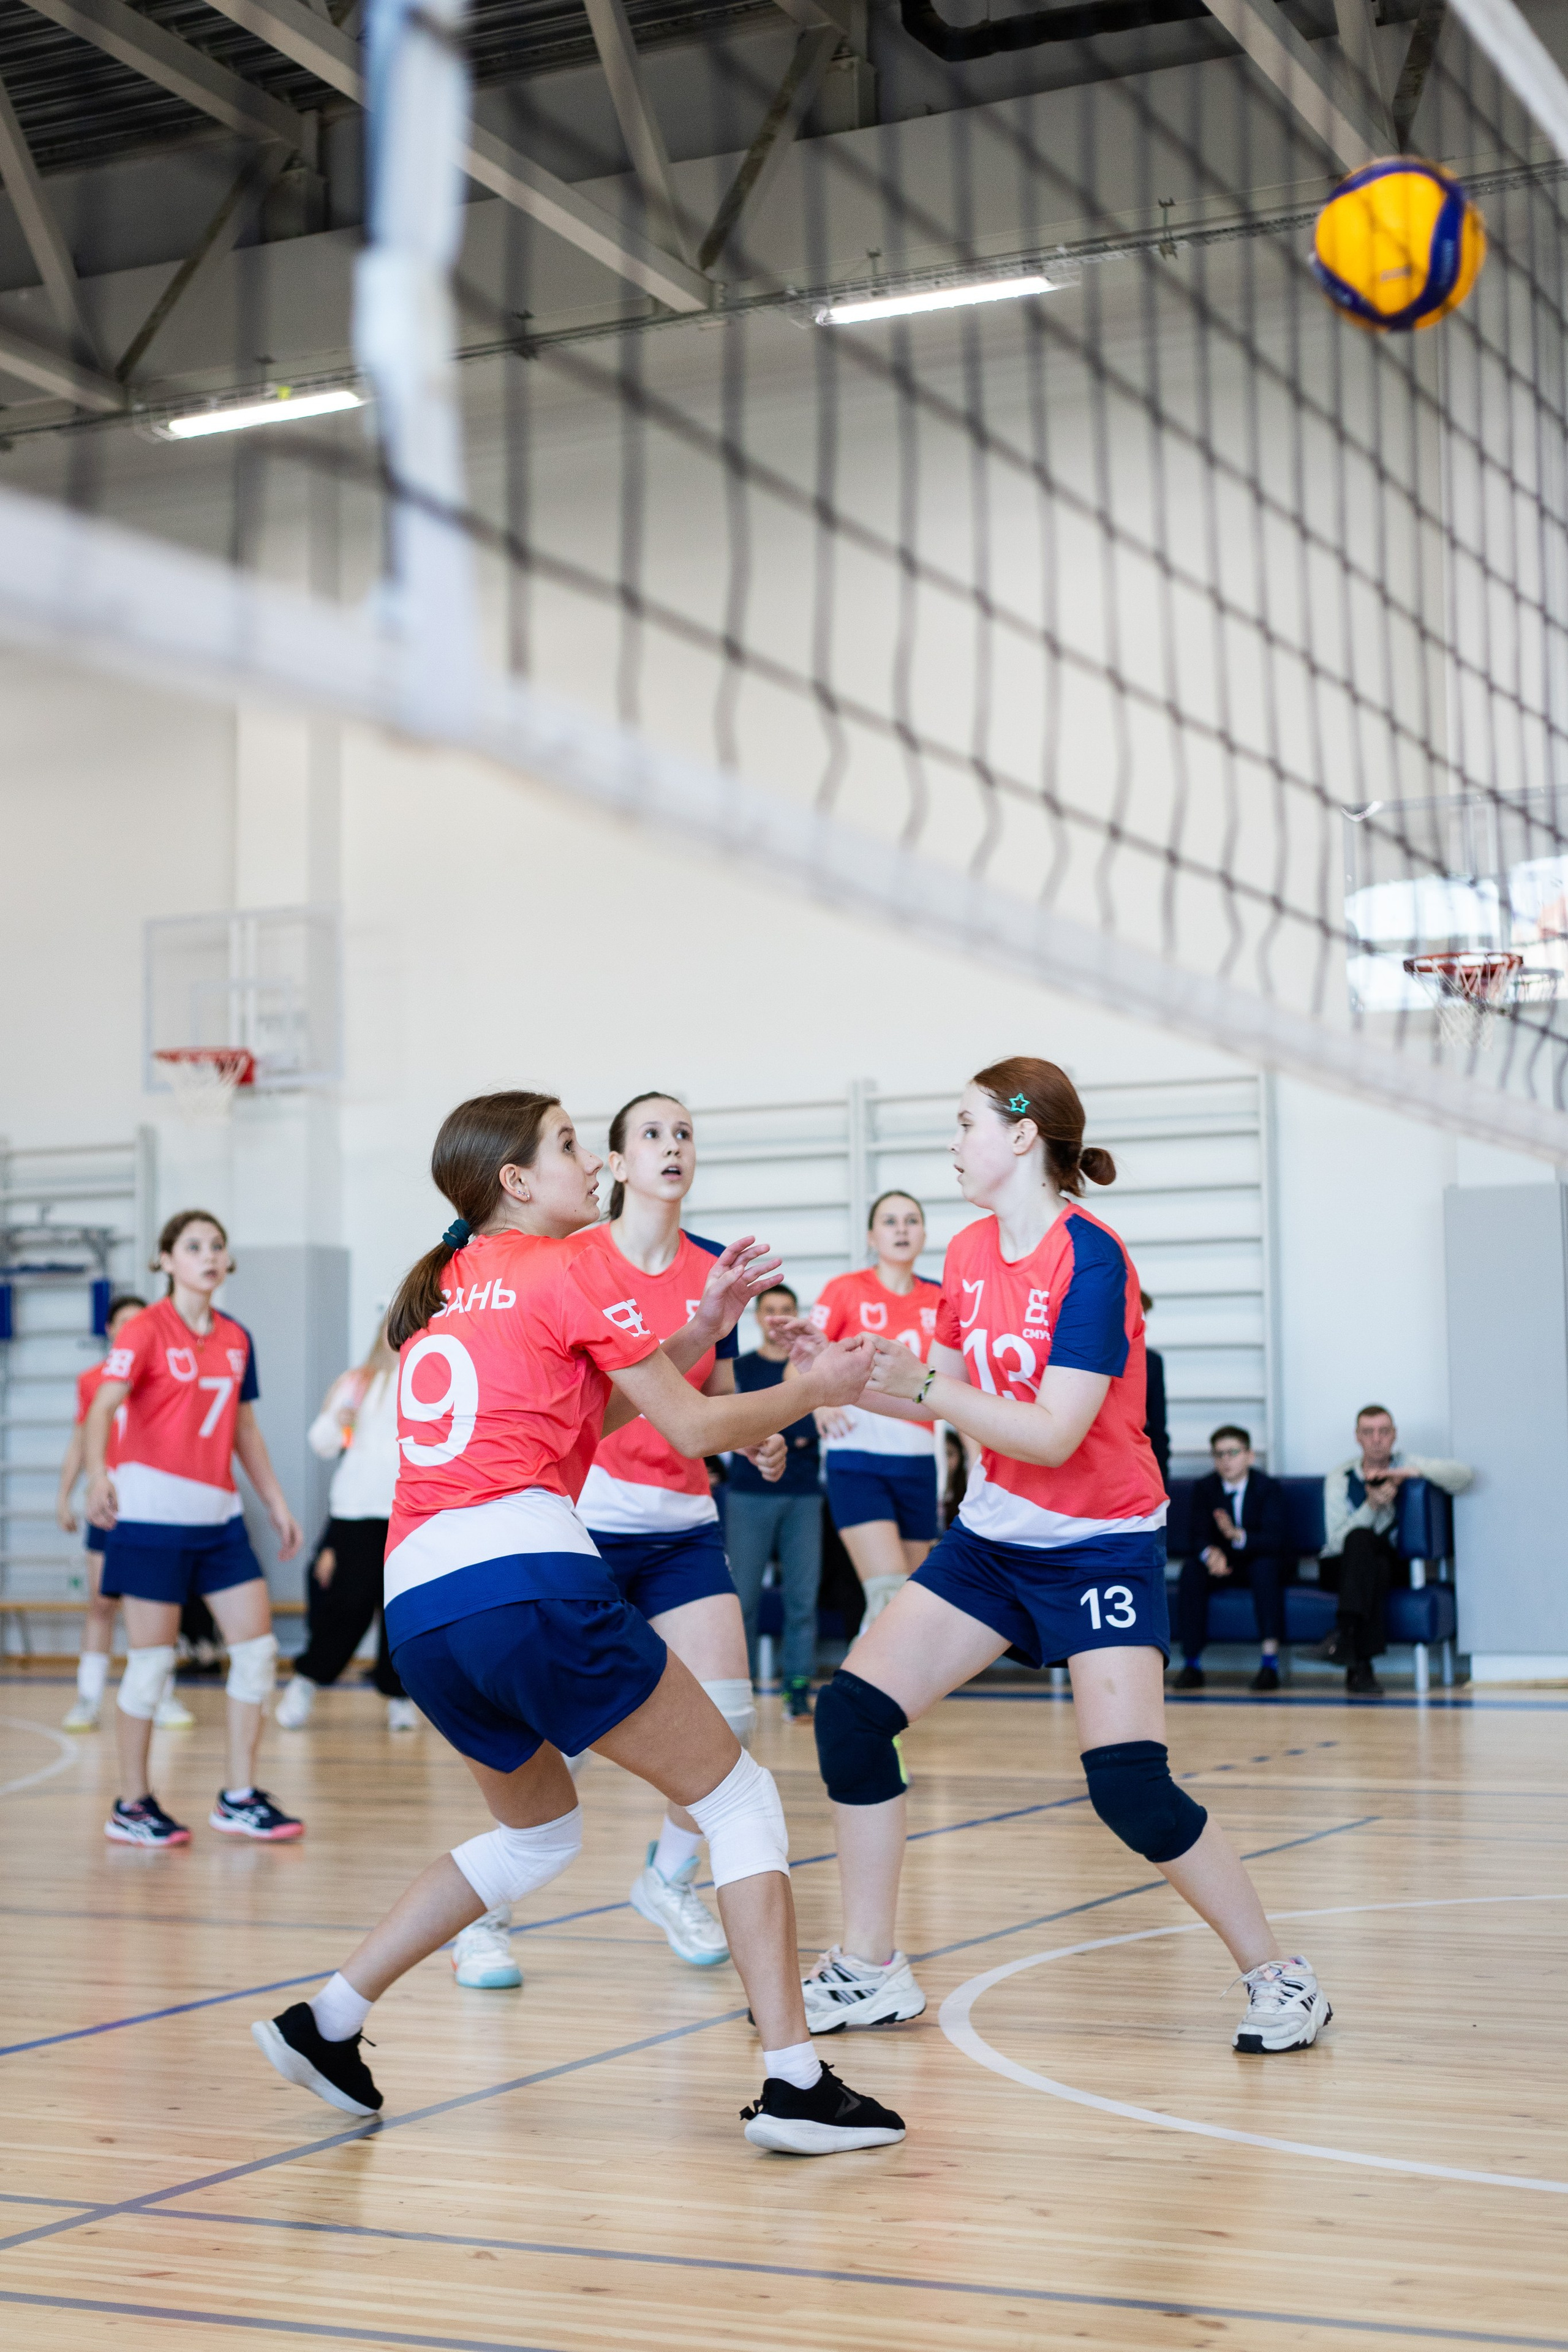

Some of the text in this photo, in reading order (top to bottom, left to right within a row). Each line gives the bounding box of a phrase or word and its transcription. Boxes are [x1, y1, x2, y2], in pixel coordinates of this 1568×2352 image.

[198, 1377, 233, 1437] 7
[398, 1334, 478, 1466] 9
[1080, 1585, 1137, 1630] 13
